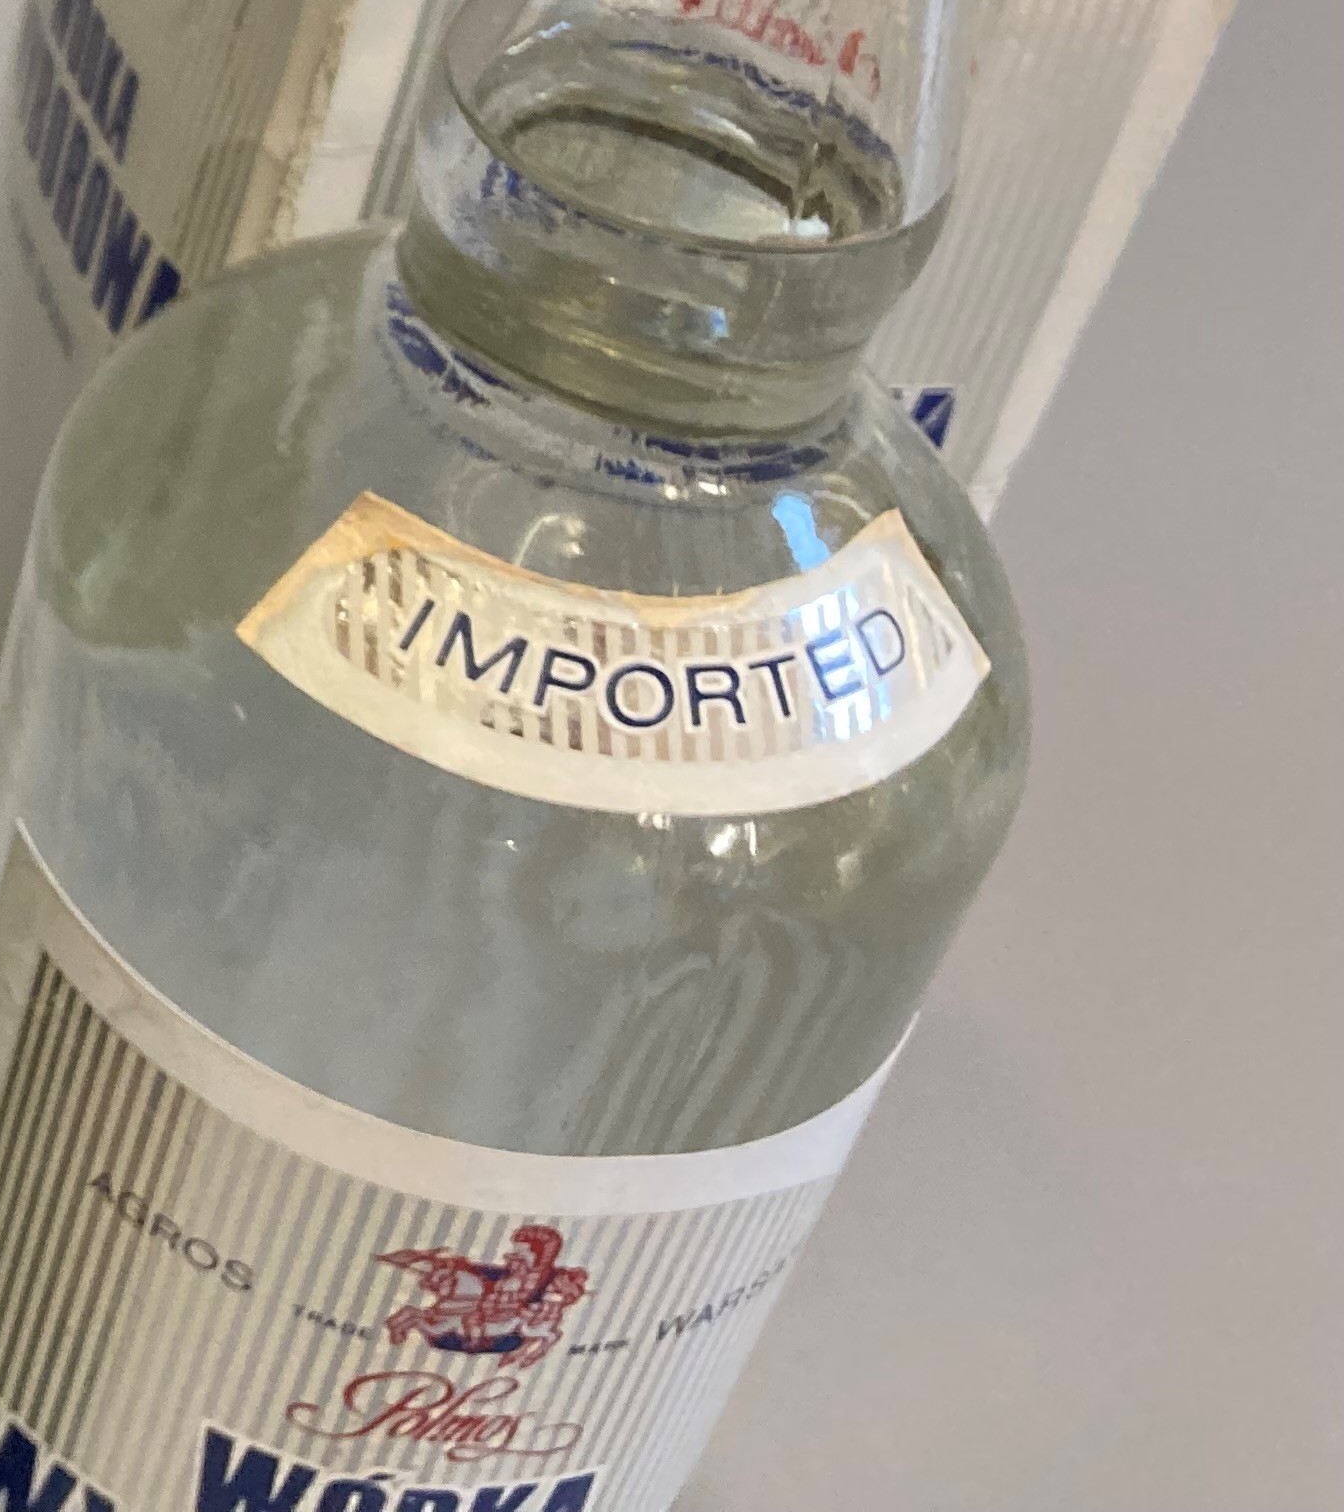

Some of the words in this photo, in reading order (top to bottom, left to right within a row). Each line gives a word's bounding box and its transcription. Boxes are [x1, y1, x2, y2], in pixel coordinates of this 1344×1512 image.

[400, 599, 907, 728] IMPORTED
[86, 1170, 255, 1294] AGROS
[284, 1370, 584, 1463] Polmos
